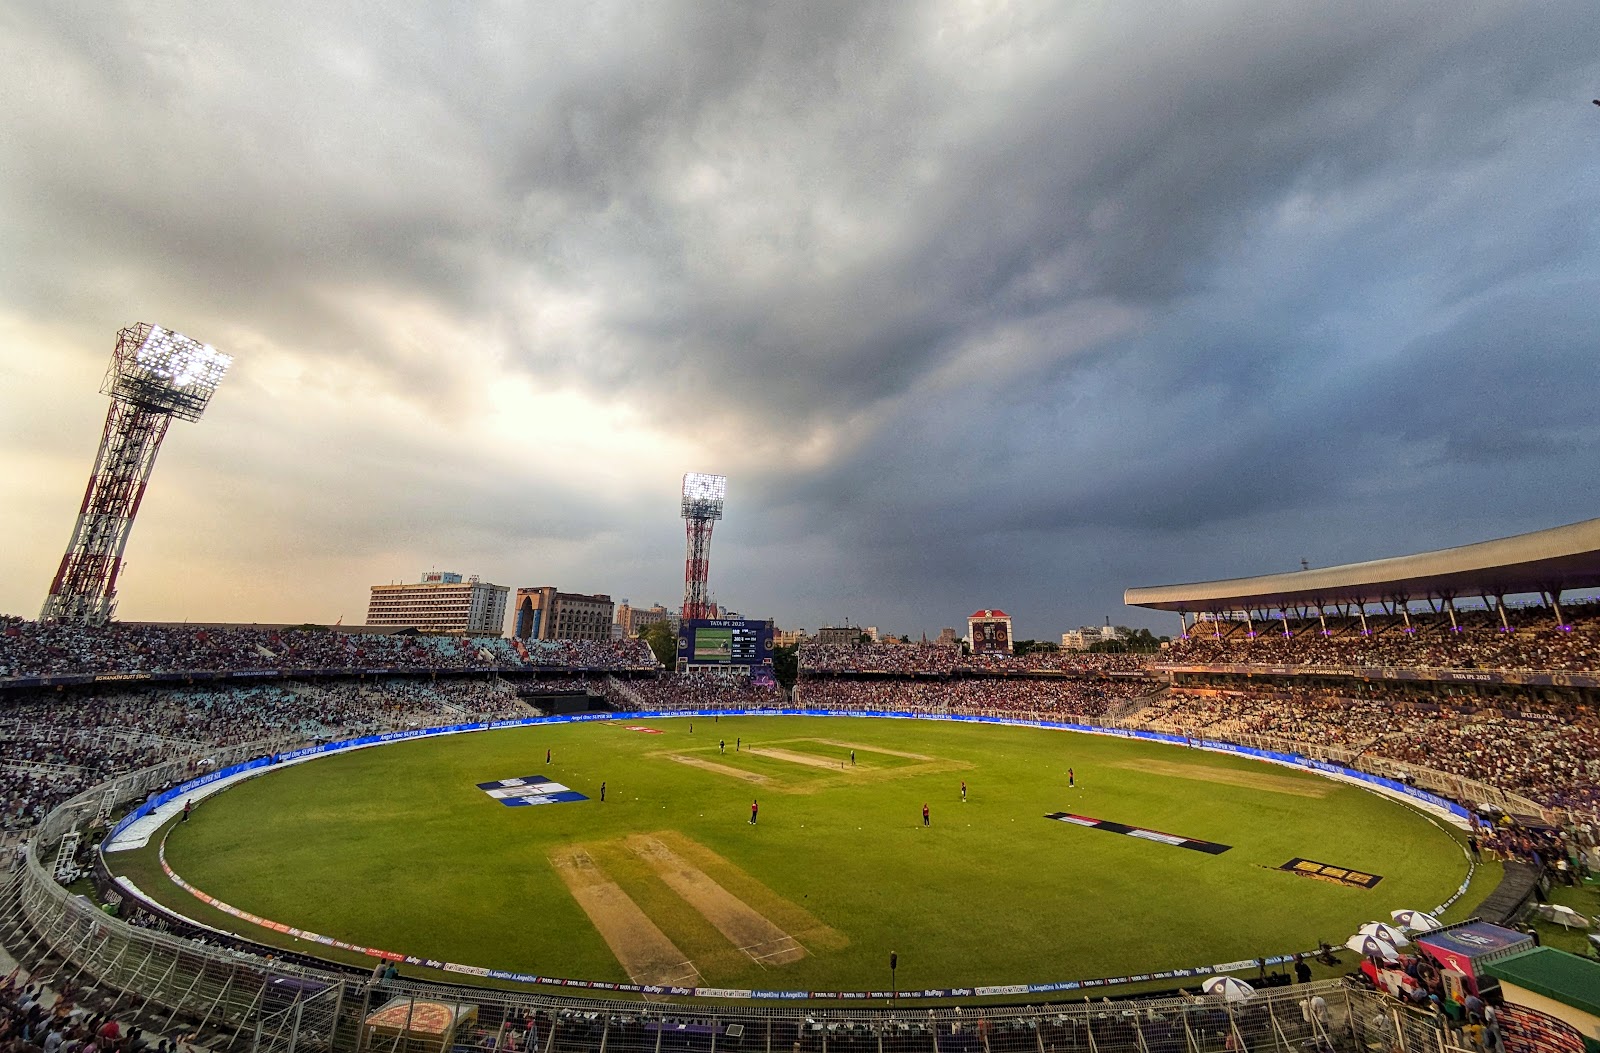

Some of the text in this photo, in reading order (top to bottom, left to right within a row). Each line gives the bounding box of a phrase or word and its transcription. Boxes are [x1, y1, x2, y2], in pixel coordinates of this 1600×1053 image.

[1521, 712, 1558, 721] IPLT20.COM
[380, 733, 393, 741] Angel
[279, 752, 291, 761] Angel
[292, 750, 301, 758] One
[302, 747, 317, 756] SUPER
[1295, 757, 1308, 767] Angel
[1320, 762, 1335, 772] SUPER
[180, 771, 222, 793] Angel One SUPER SIX
[1417, 790, 1428, 800] One
[1428, 793, 1443, 807] SUPER
[643, 985, 662, 994] RuPay
[671, 987, 689, 995] RuPay
[925, 989, 943, 997] RuPay
[952, 988, 969, 996] RuPay
[757, 991, 779, 999] AngelOne
[786, 991, 808, 999] AngelOne
